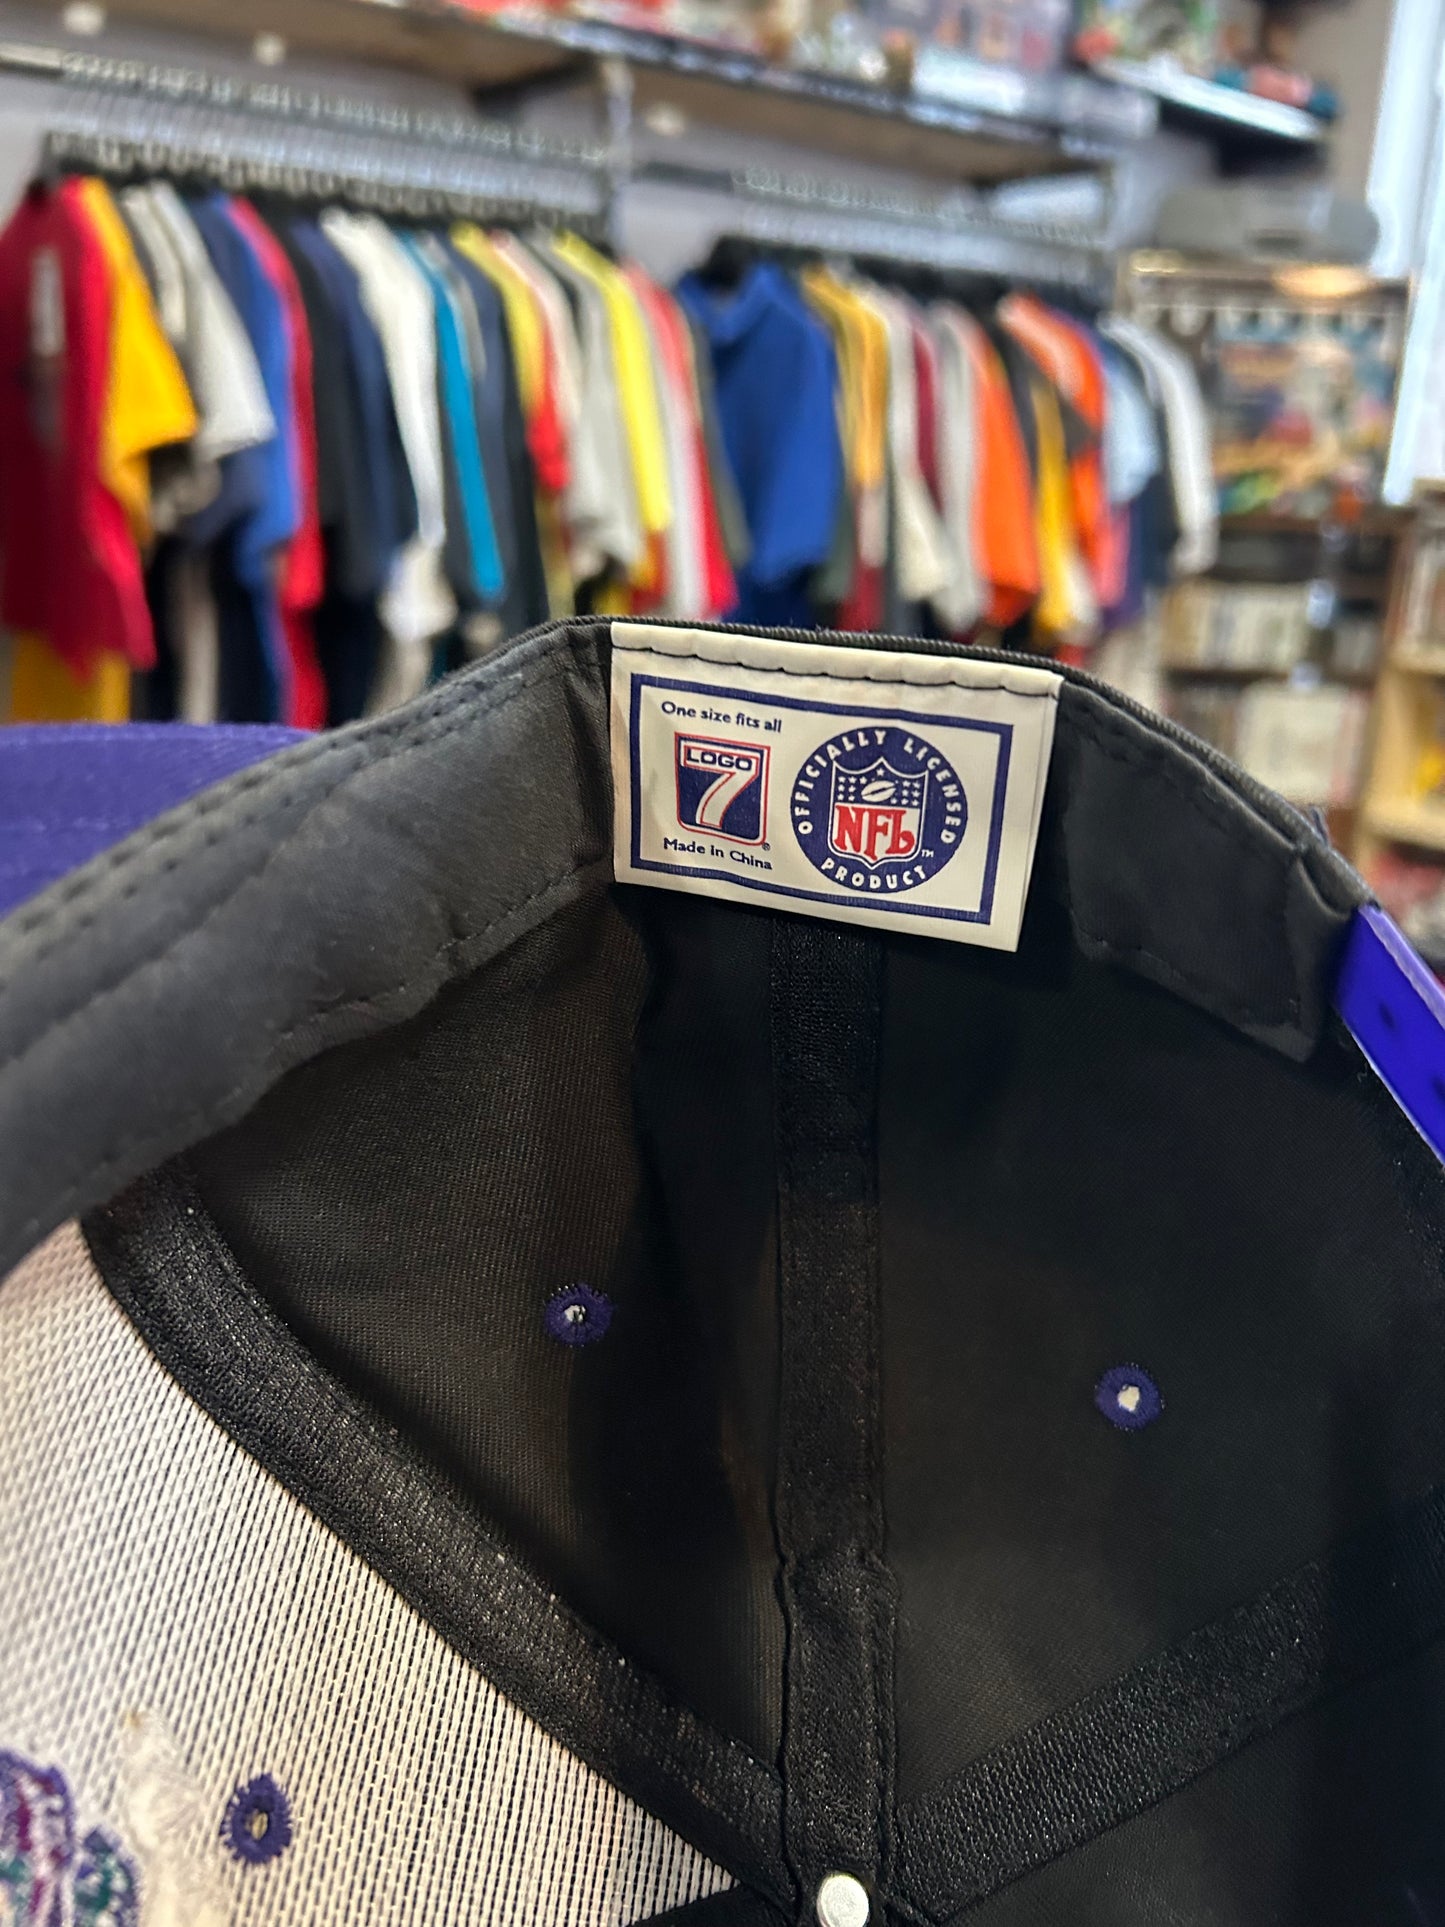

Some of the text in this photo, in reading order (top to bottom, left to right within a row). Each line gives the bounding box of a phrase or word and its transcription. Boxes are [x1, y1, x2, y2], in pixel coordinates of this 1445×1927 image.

[661, 701, 782, 733] One size fits all
[686, 748, 753, 772] LOGO
[680, 740, 760, 829] 7
[795, 730, 962, 844] OFFICIALLY LICENSED
[833, 805, 915, 861] NFL
[663, 837, 773, 870] Made in China
[821, 857, 927, 889] PRODUCT
